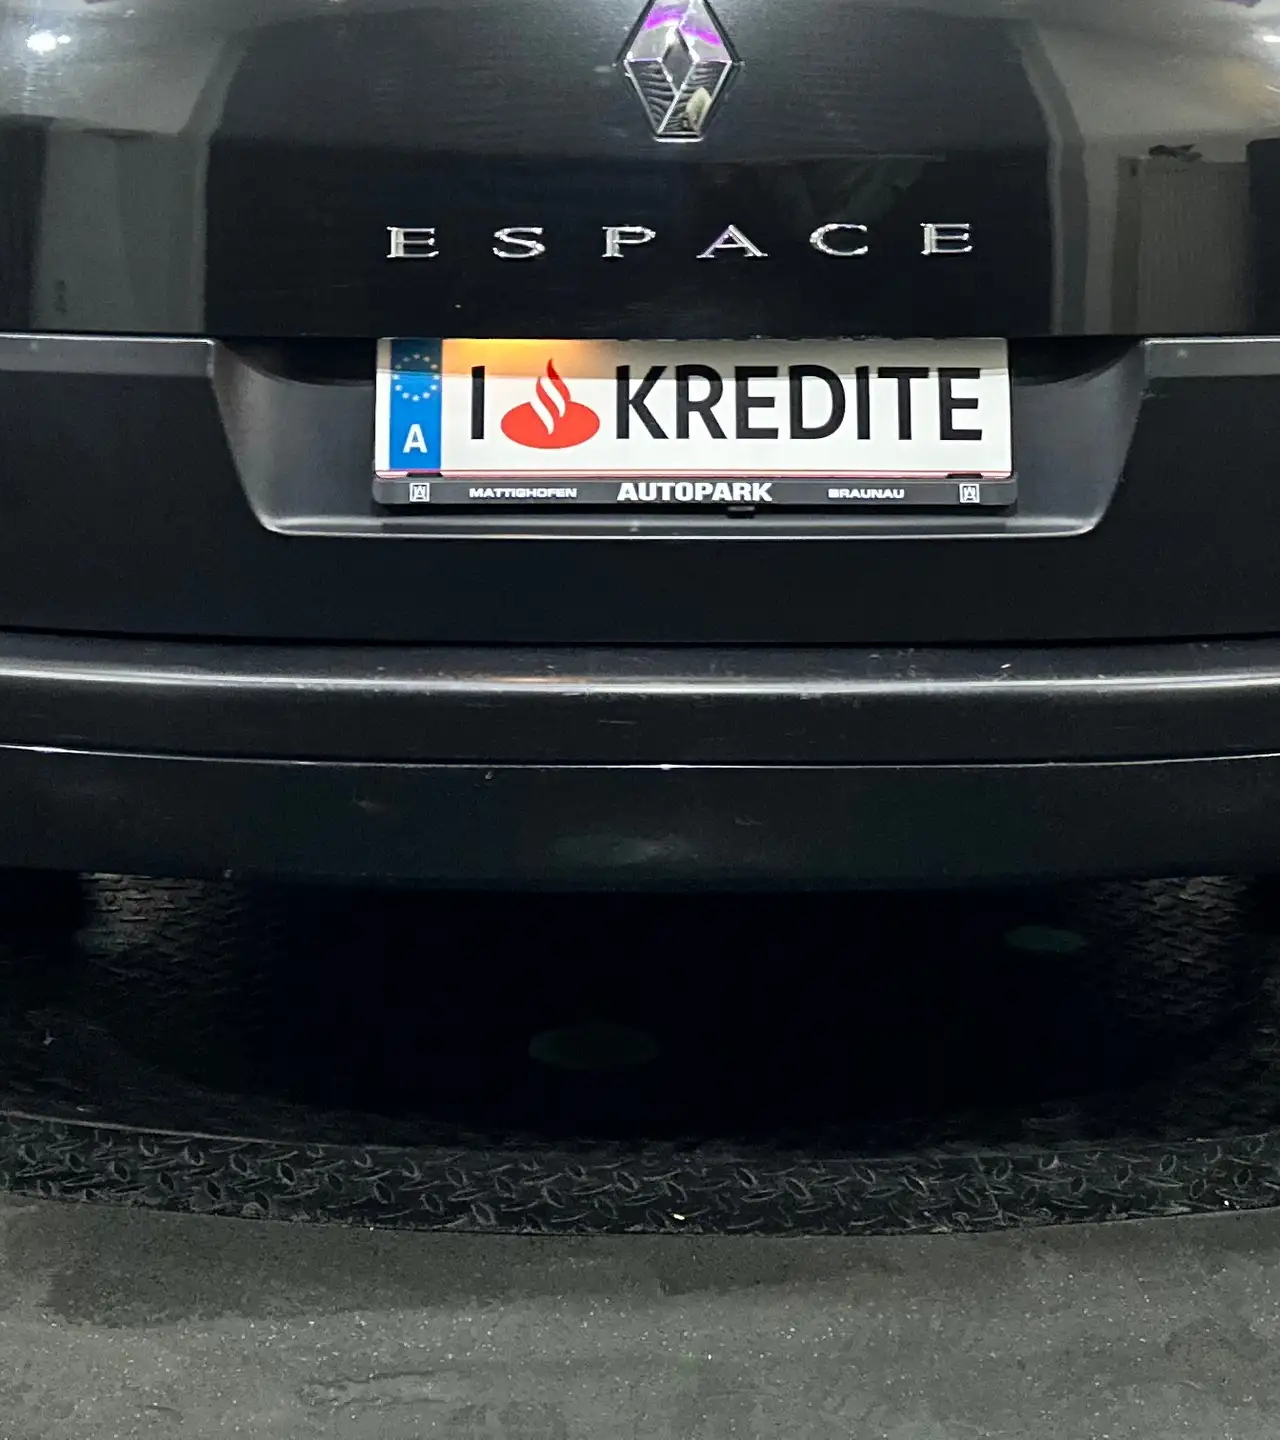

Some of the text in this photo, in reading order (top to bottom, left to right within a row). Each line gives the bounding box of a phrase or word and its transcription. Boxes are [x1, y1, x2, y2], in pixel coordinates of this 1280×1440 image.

[386, 222, 975, 259] ESPACE
[402, 364, 984, 454] A I KREDITE
[469, 482, 905, 503] MATTIGHOFEN AUTOPARK BRAUNAU
